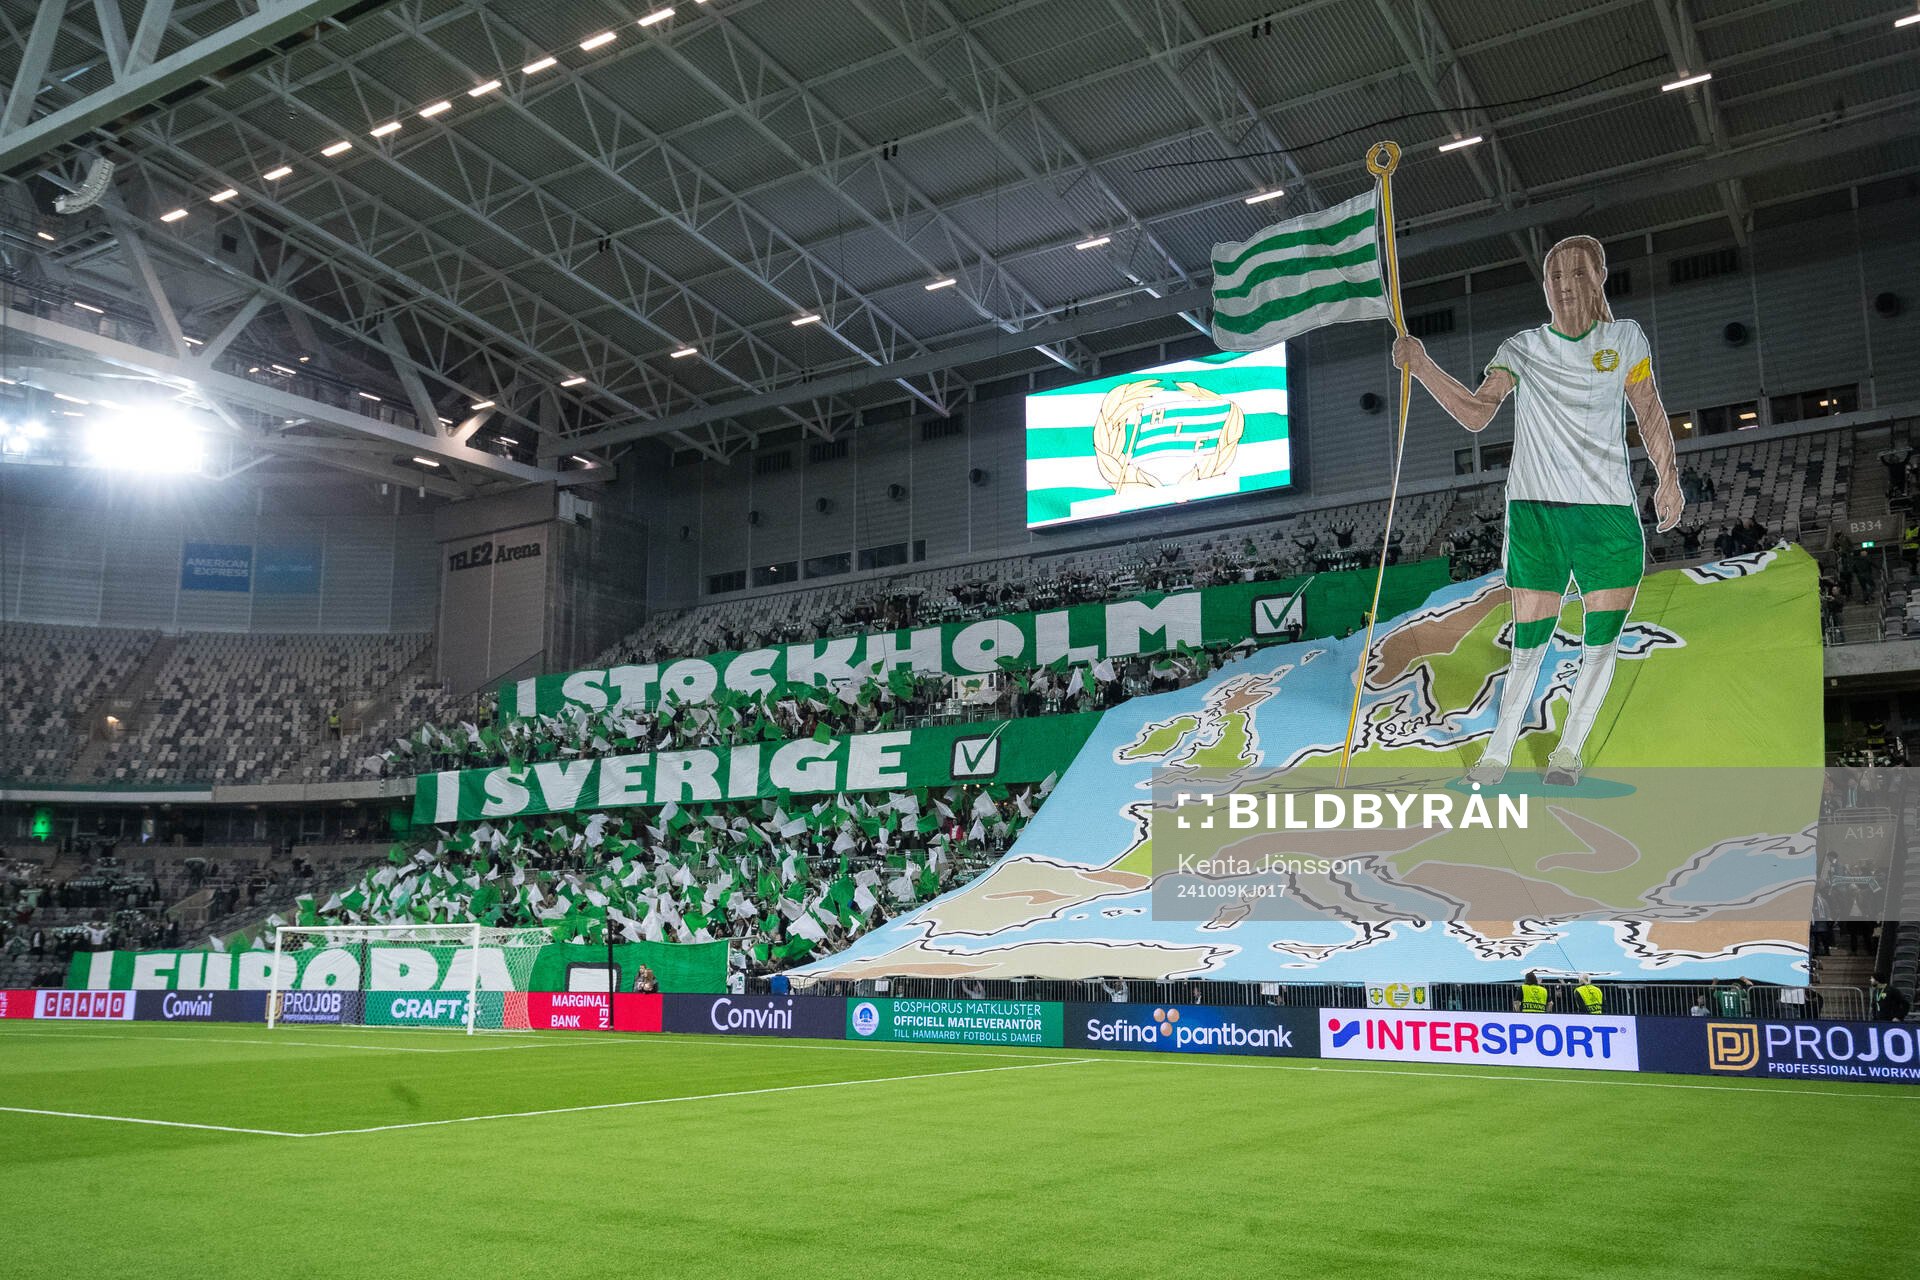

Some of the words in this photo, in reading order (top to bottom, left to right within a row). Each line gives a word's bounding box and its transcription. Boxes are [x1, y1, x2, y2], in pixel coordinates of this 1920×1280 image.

[1850, 520, 1882, 533] B334
[185, 558, 249, 568] AMERICAN
[449, 541, 493, 572] TELE2
[495, 543, 541, 563] Arena
[192, 568, 249, 577] EXPRESS
[516, 677, 536, 717] I
[562, 592, 1201, 713] STOCKHOLM
[434, 771, 460, 823] I
[481, 731, 911, 817] SVERIGE
[1845, 826, 1885, 839] A134
[87, 951, 113, 991] I
[132, 948, 515, 991] EUROPA
[46, 996, 122, 1013] CRAMO
[163, 993, 213, 1018] Convini
[284, 993, 341, 1013] PROJOB
[391, 999, 462, 1019] CRAFT
[893, 1001, 962, 1014] BOSPHORUS
[966, 1003, 1041, 1016] MATKLUSTER
[551, 1015, 580, 1027] BANK
[711, 998, 793, 1030] Convini
[893, 1016, 944, 1028] OFFICIELL
[948, 1016, 1041, 1030] MATLEVERANTÖR
[893, 1029, 910, 1038] TILL
[913, 1030, 960, 1040] HAMMARBY
[963, 1032, 1008, 1042] FOTBOLLS
[1010, 1033, 1042, 1043] DAMER
[1087, 1018, 1157, 1043] Sefina
[1177, 1023, 1293, 1049] pantbank
[1765, 1024, 1920, 1063] PROJO
[1768, 1063, 1867, 1077] PROFESSIONAL
